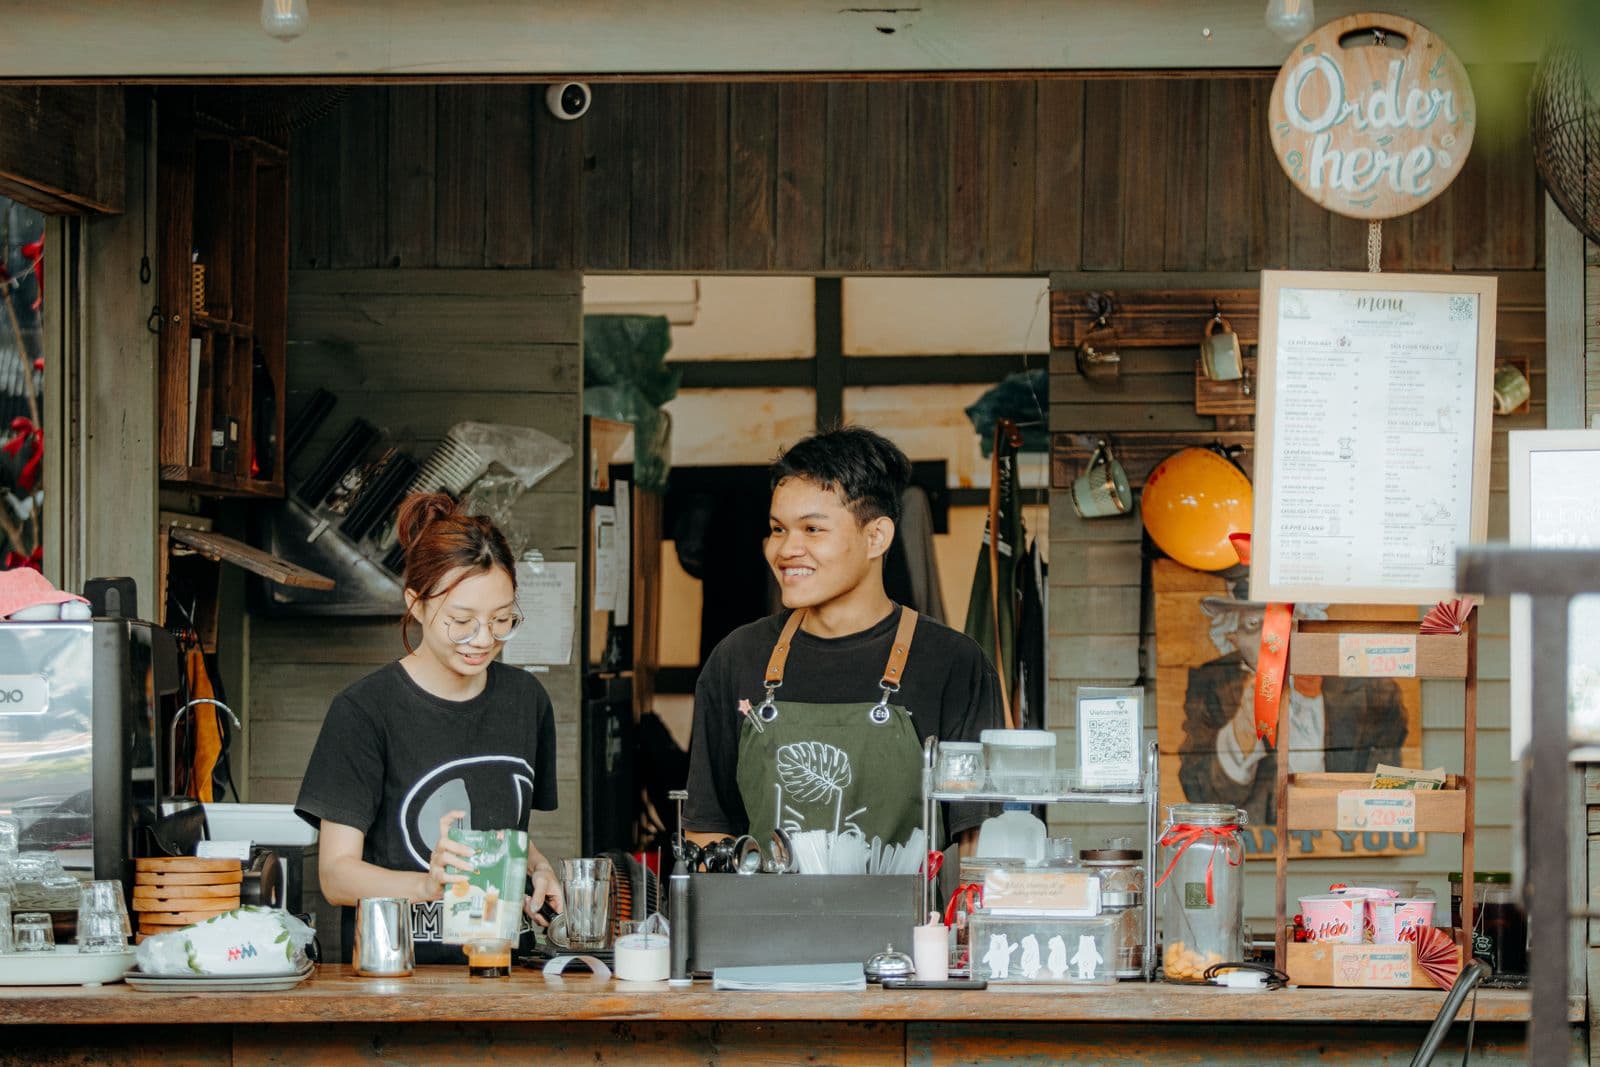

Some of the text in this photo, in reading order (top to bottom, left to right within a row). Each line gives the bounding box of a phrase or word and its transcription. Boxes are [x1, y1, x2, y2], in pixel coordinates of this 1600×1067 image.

[1284, 52, 1457, 132] Order
[1308, 132, 1435, 196] here
[1334, 830, 1418, 852] YOU
